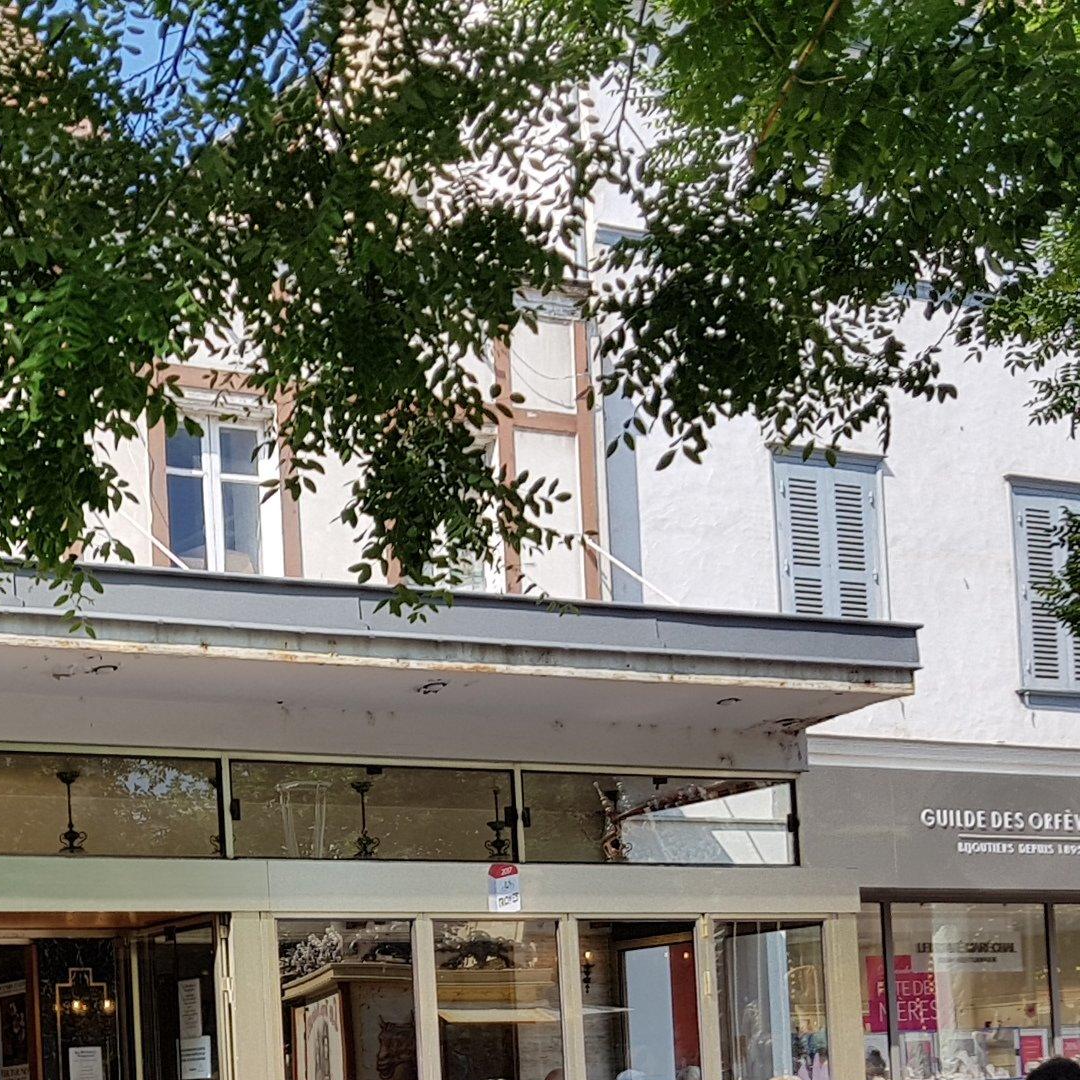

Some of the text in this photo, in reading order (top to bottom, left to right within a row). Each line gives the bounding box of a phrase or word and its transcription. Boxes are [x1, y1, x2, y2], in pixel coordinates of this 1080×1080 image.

[920, 808, 986, 828] GUILDE
[991, 811, 1025, 830] DES
[876, 980, 911, 998] FTE
